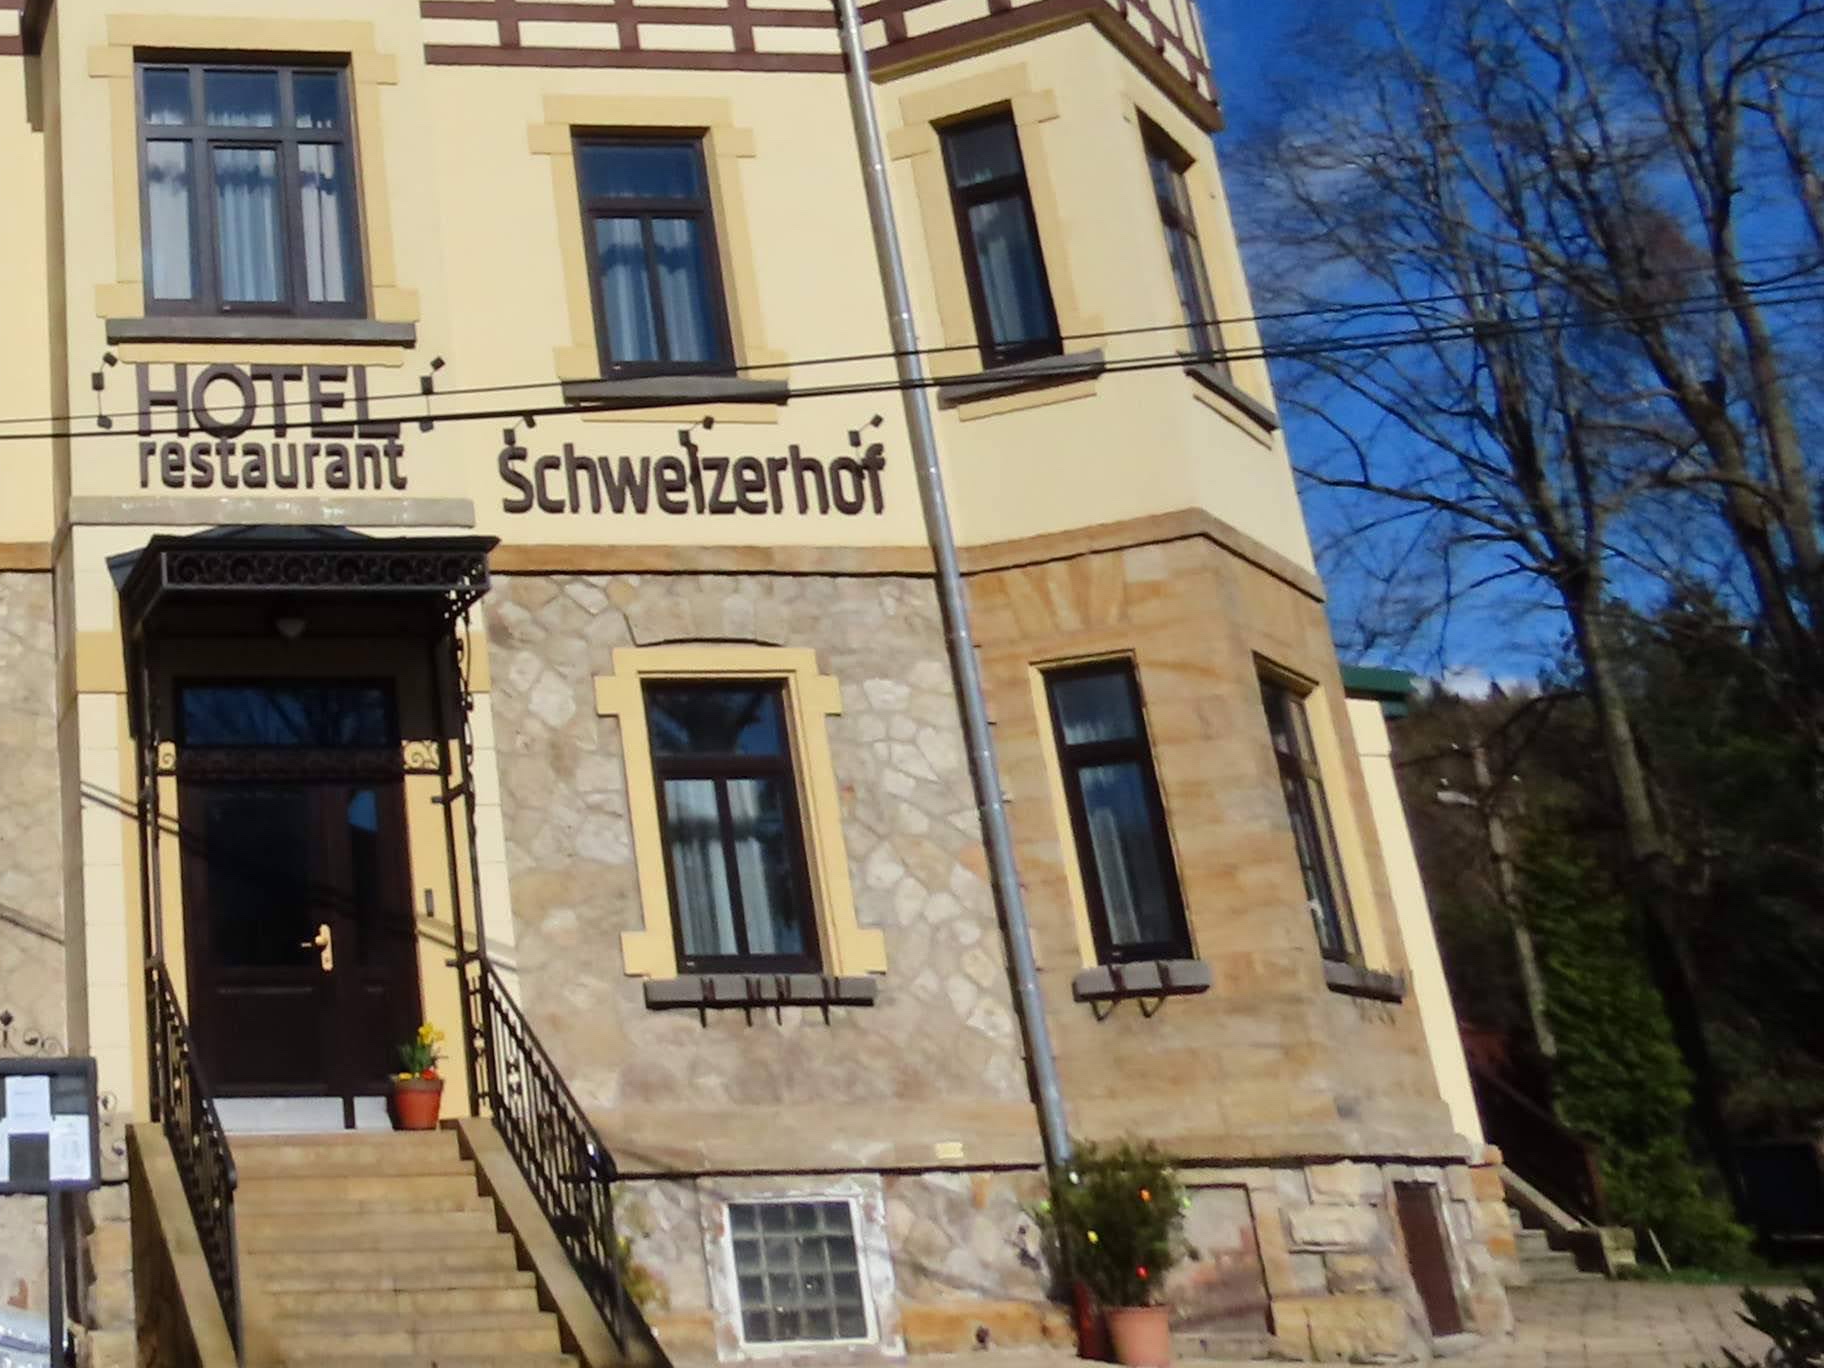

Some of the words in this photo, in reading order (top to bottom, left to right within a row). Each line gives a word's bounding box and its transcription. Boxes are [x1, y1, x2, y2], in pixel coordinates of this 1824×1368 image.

[135, 362, 401, 439] HOTEL
[138, 436, 408, 490] restaurant
[498, 441, 885, 515] Schweizerhof
